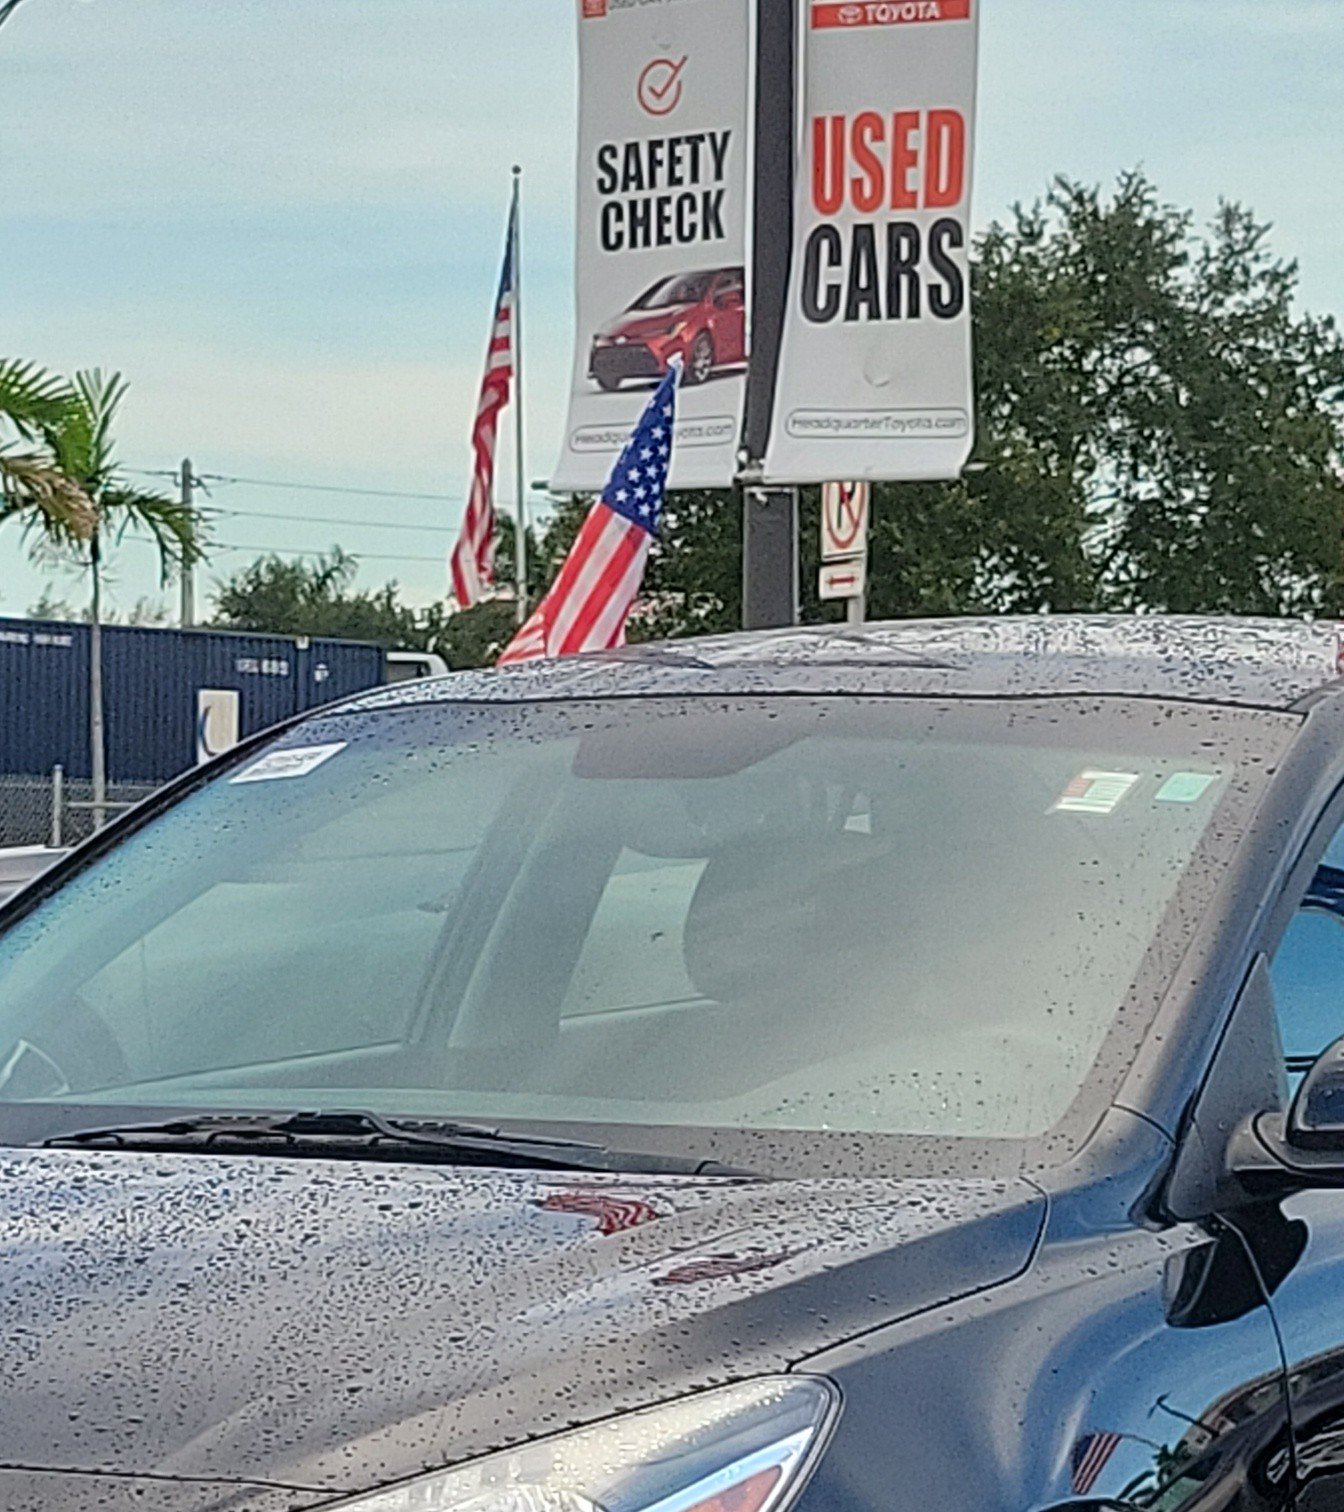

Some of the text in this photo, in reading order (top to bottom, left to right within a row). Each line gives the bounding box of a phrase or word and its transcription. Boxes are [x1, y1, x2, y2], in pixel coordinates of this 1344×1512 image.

[864, 1, 940, 23] TOYOTA
[597, 130, 732, 195] SAFETY
[810, 108, 966, 216] USED
[601, 189, 726, 252] CHECK
[802, 218, 964, 323] CARS
